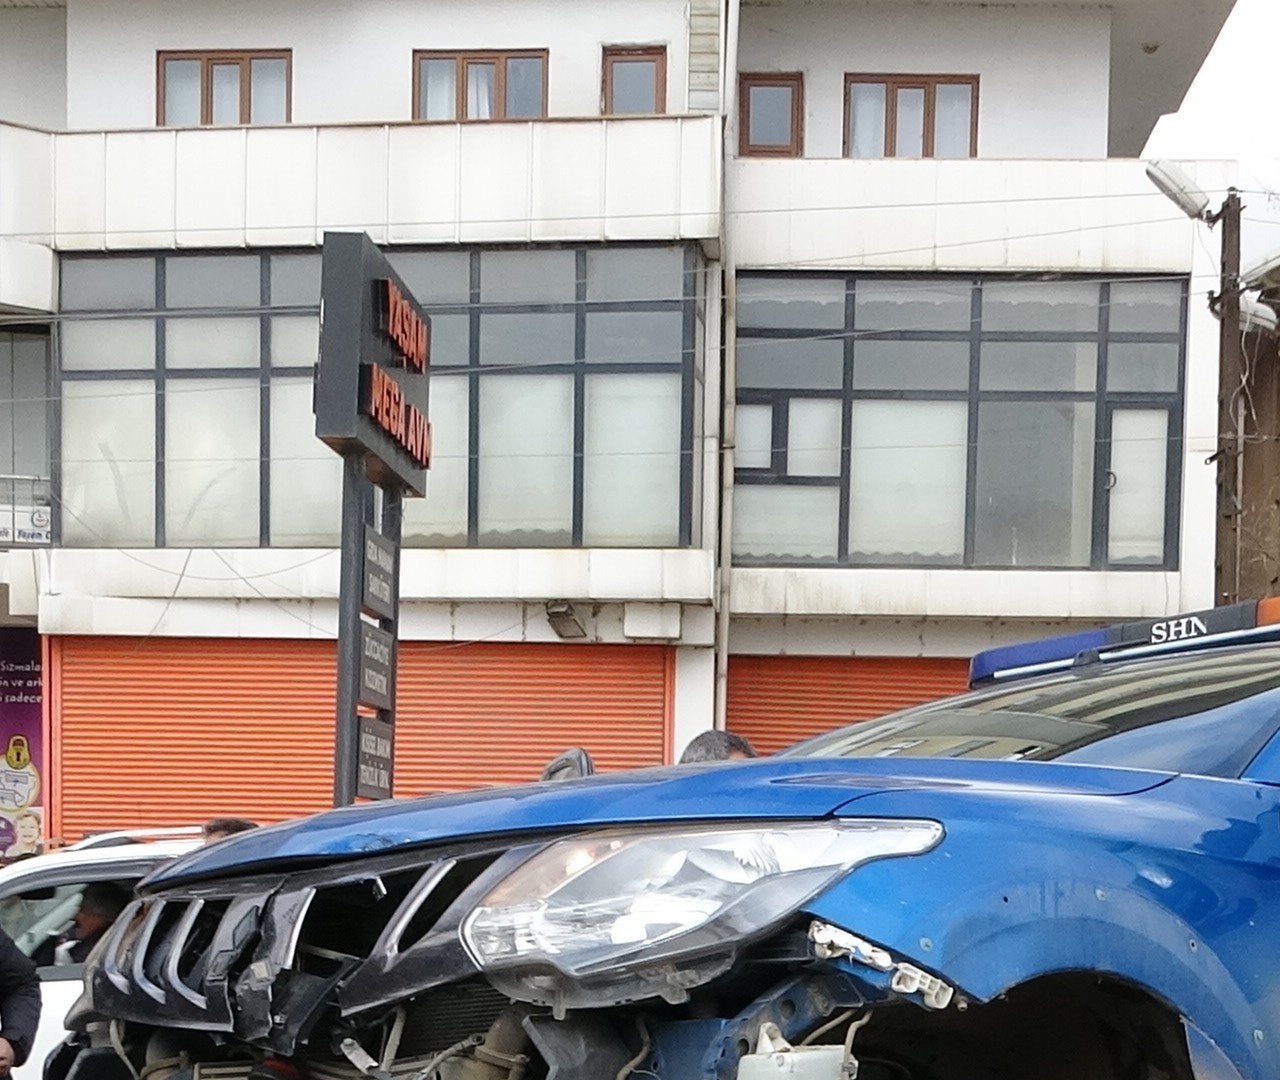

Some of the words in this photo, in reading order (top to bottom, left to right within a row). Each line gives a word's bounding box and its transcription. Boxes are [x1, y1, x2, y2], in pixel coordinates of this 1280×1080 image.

[388, 277, 428, 374] YAŞAM
[371, 362, 405, 446] MEGA
[407, 403, 433, 470] AVM
[1151, 616, 1207, 643] SHN
